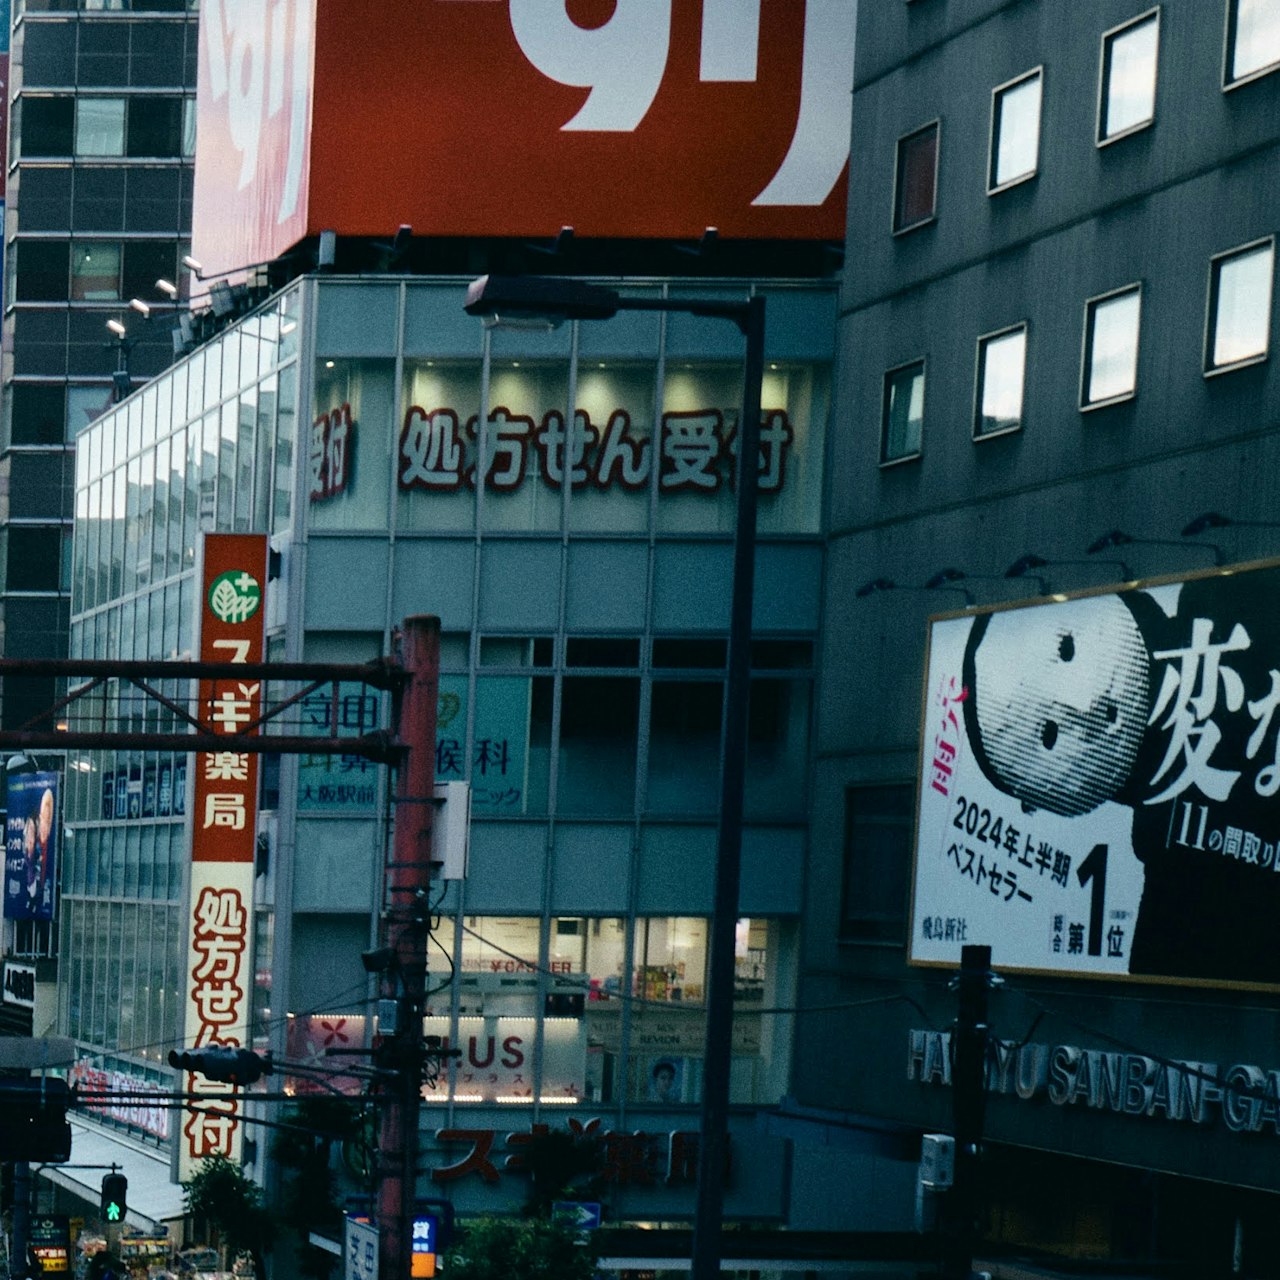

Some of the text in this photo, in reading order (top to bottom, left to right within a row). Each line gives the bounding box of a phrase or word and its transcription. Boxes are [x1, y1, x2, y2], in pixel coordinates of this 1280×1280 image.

[398, 405, 793, 495] 処方せん受付
[203, 639, 251, 831] スギ薬局
[952, 794, 1073, 891] 2024年上半期
[1175, 801, 1280, 873] 11の間取り
[946, 843, 1034, 904] ベストセラー
[505, 961, 572, 974] CASIER
[907, 1029, 1043, 1101] HAYU
